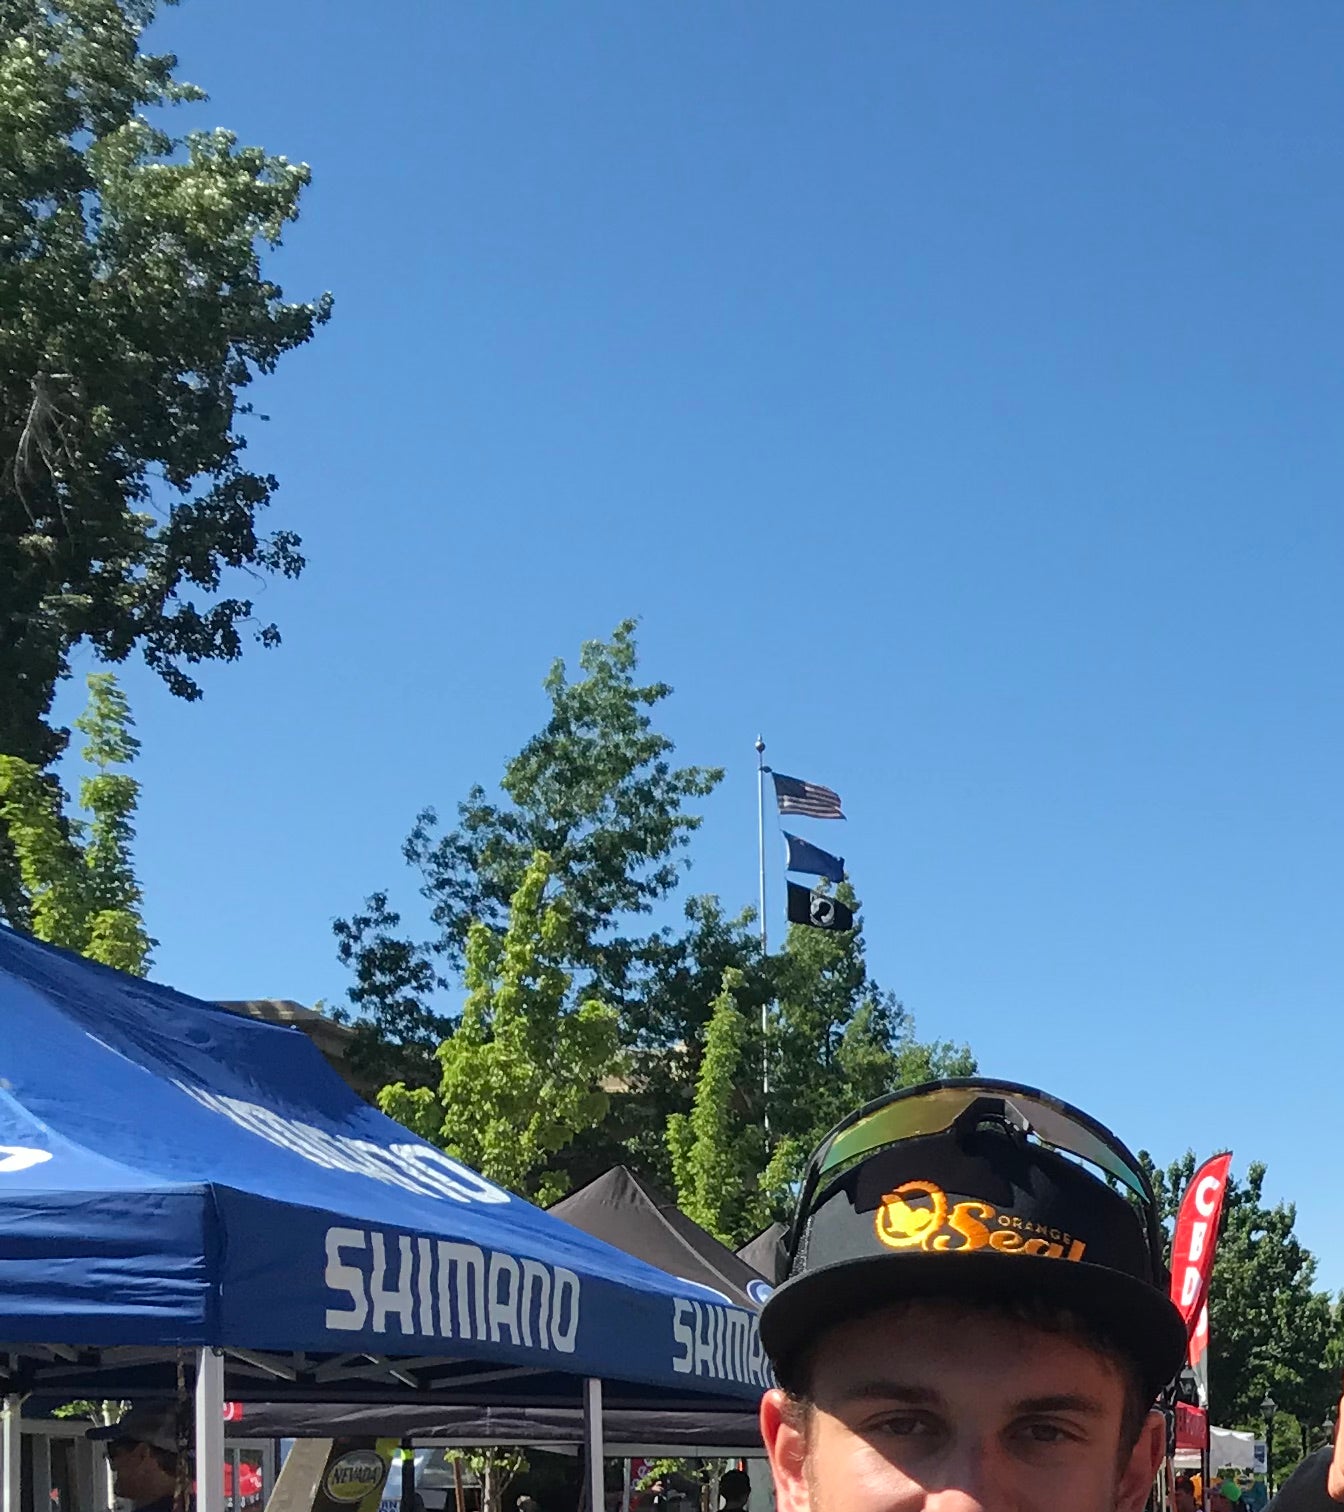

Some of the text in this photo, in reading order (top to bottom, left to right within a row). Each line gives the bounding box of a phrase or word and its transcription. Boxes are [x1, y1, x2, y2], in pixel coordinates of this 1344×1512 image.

[922, 1200, 1087, 1262] Seal
[998, 1215, 1073, 1245] ORANGE
[325, 1226, 581, 1354] SHIMANO
[673, 1297, 780, 1389] SHIMA
